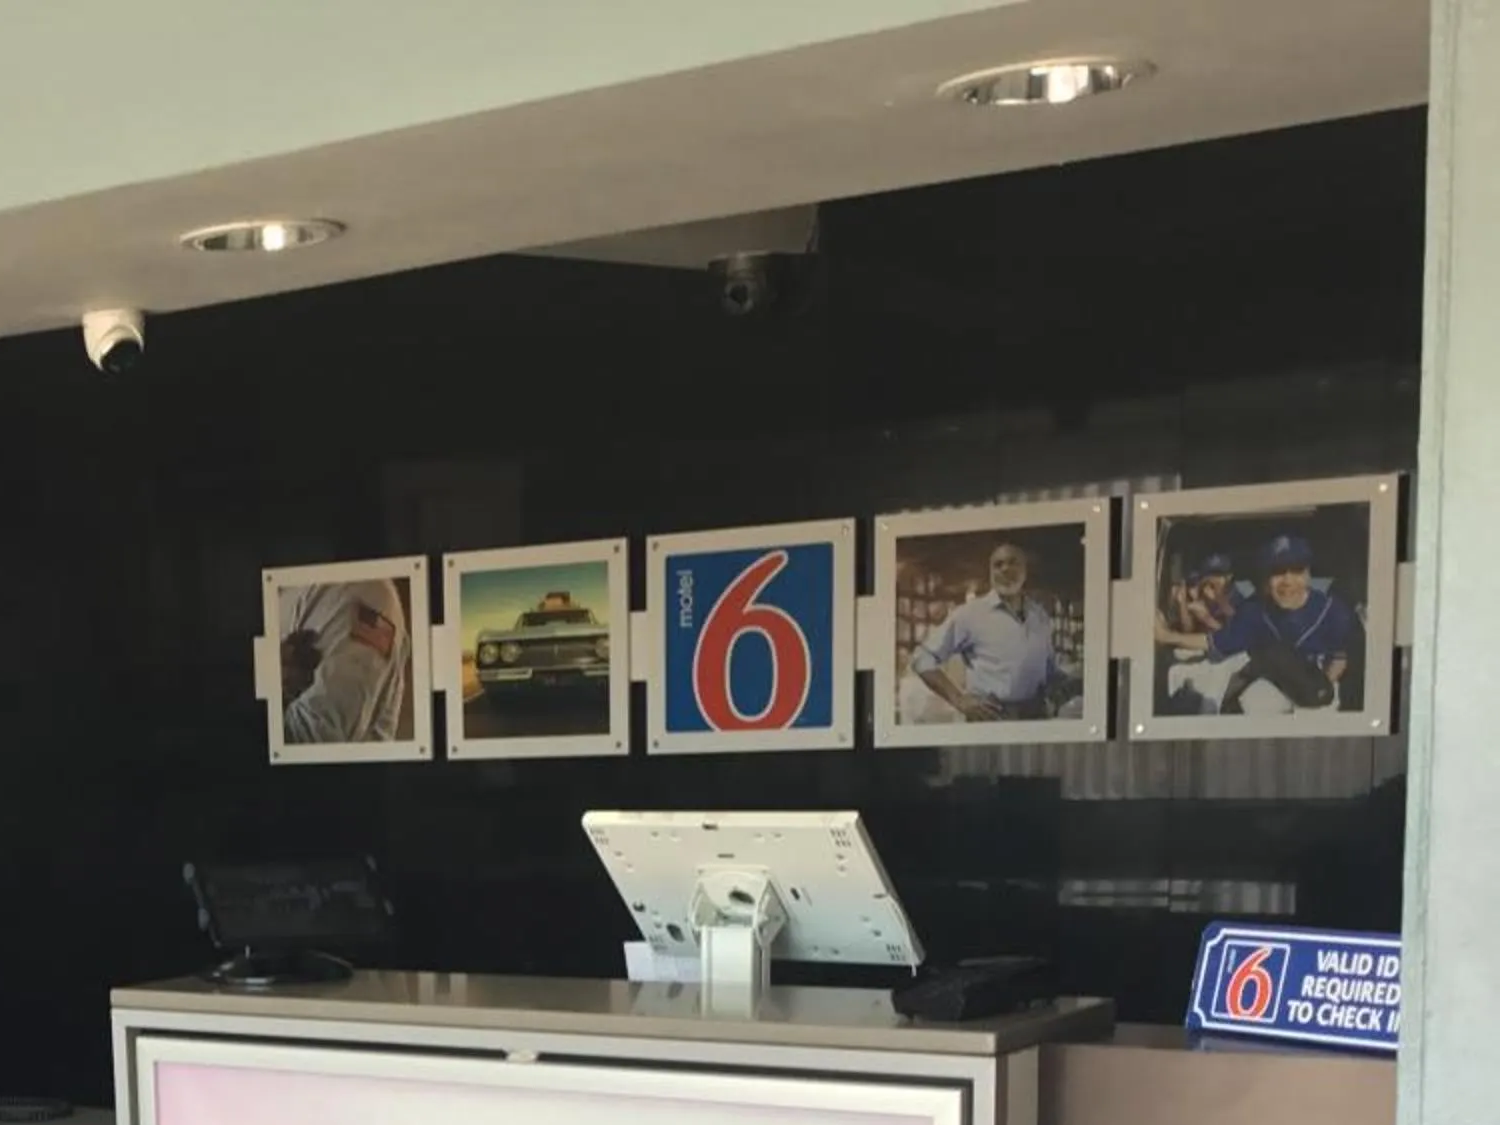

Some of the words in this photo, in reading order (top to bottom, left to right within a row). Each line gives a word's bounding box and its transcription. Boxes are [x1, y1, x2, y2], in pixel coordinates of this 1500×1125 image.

[678, 570, 693, 628] motel
[692, 550, 812, 732] 6
[1225, 944, 1274, 1021] 6
[1317, 949, 1372, 975] VALID
[1377, 955, 1399, 978] ID
[1301, 976, 1401, 1005] REQUIRED
[1287, 1000, 1311, 1023] TO
[1317, 1003, 1381, 1031] CHECK
